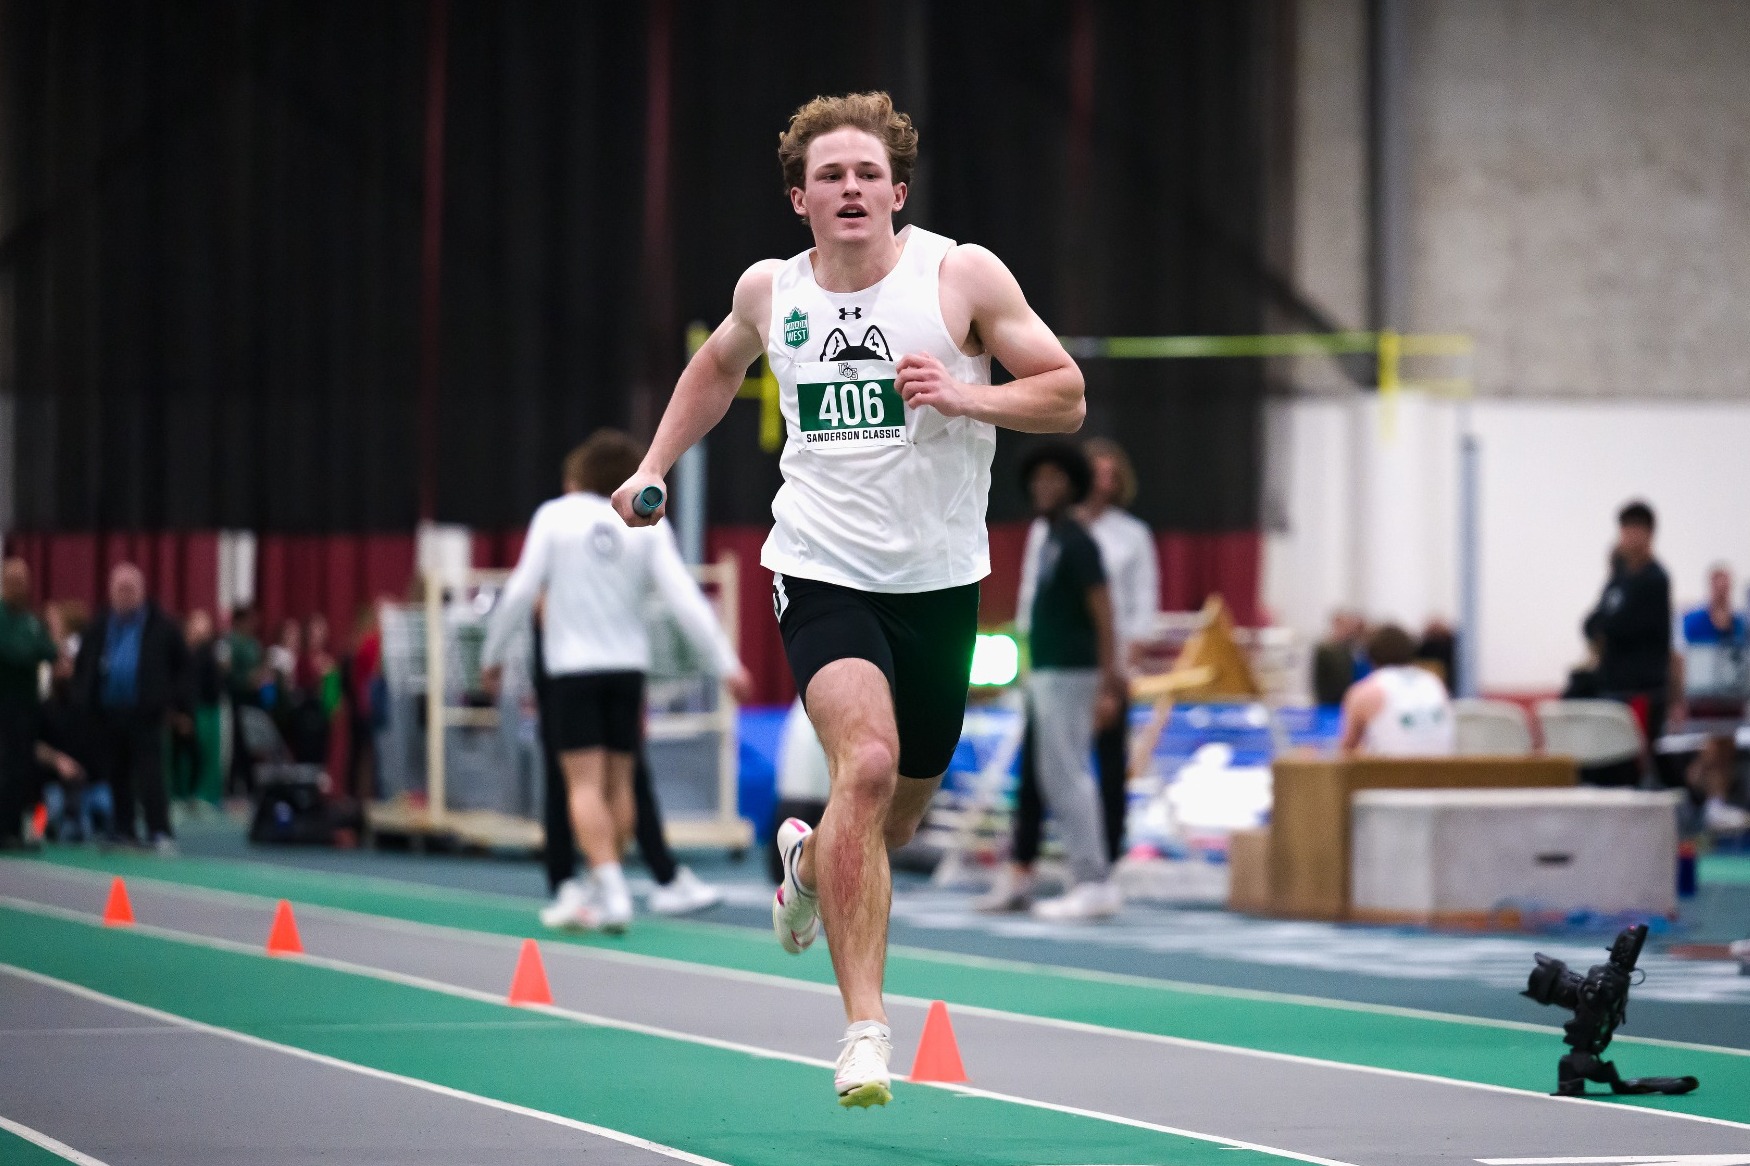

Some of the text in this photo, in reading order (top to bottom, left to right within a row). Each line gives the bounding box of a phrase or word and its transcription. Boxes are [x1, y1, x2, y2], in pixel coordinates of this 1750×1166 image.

[787, 329, 807, 342] WEST
[818, 382, 885, 427] 406
[806, 428, 900, 443] SANDERSON CLASSIC
